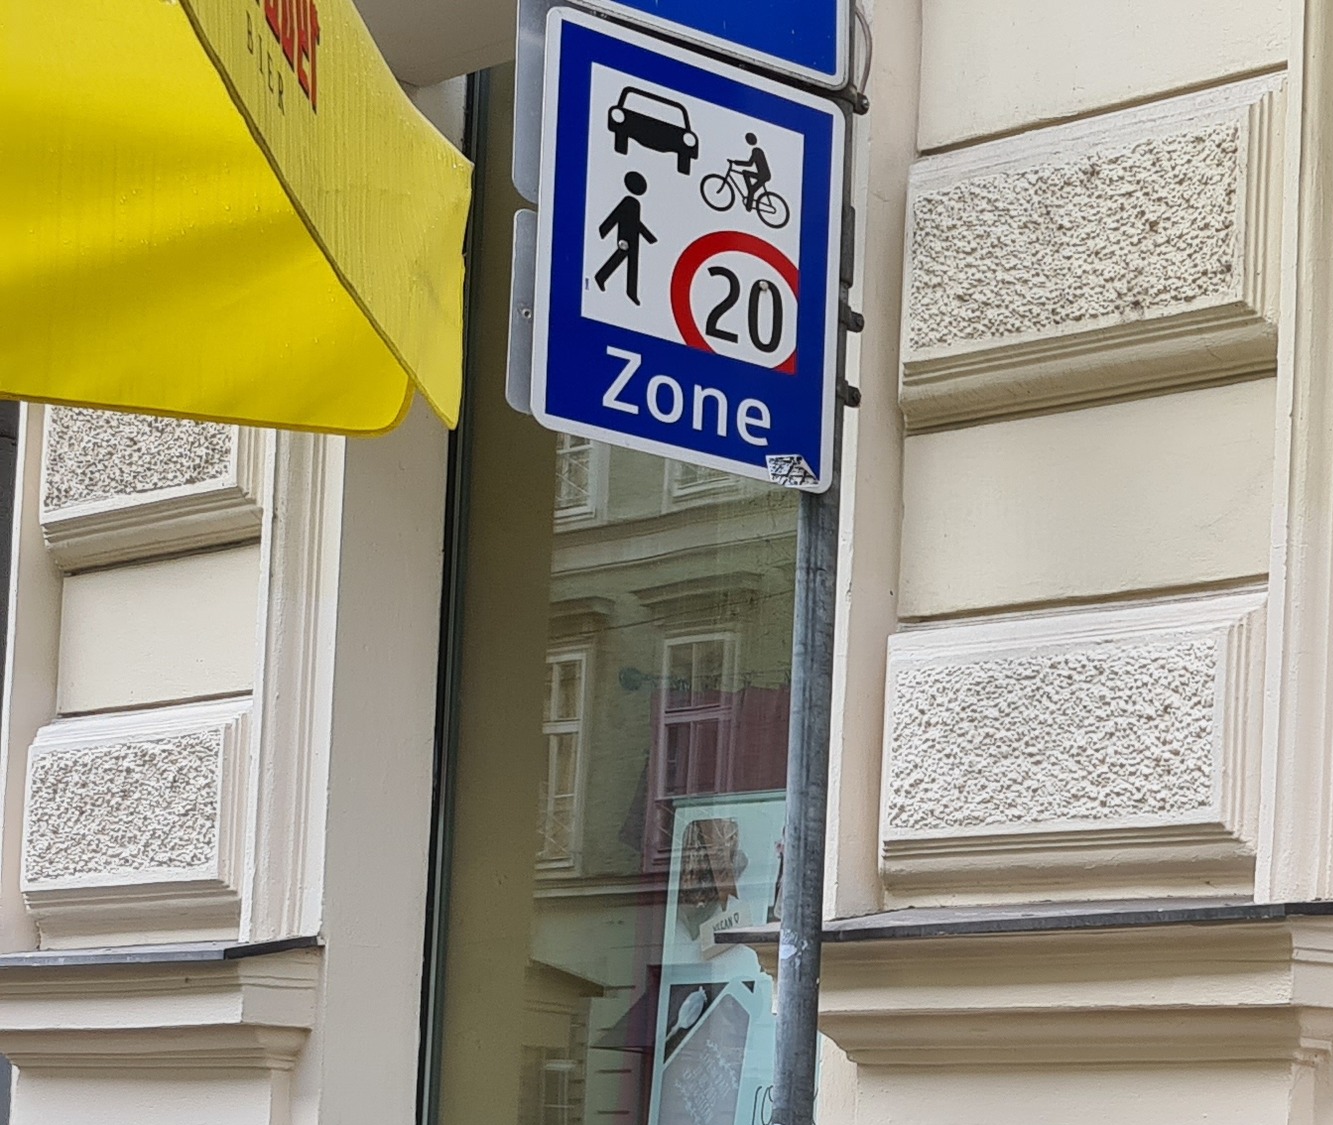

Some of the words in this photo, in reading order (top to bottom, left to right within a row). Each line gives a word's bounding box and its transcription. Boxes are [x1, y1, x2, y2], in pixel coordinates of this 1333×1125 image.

[245, 9, 285, 116] BIER
[705, 266, 783, 353] 20
[602, 345, 771, 447] Zone
